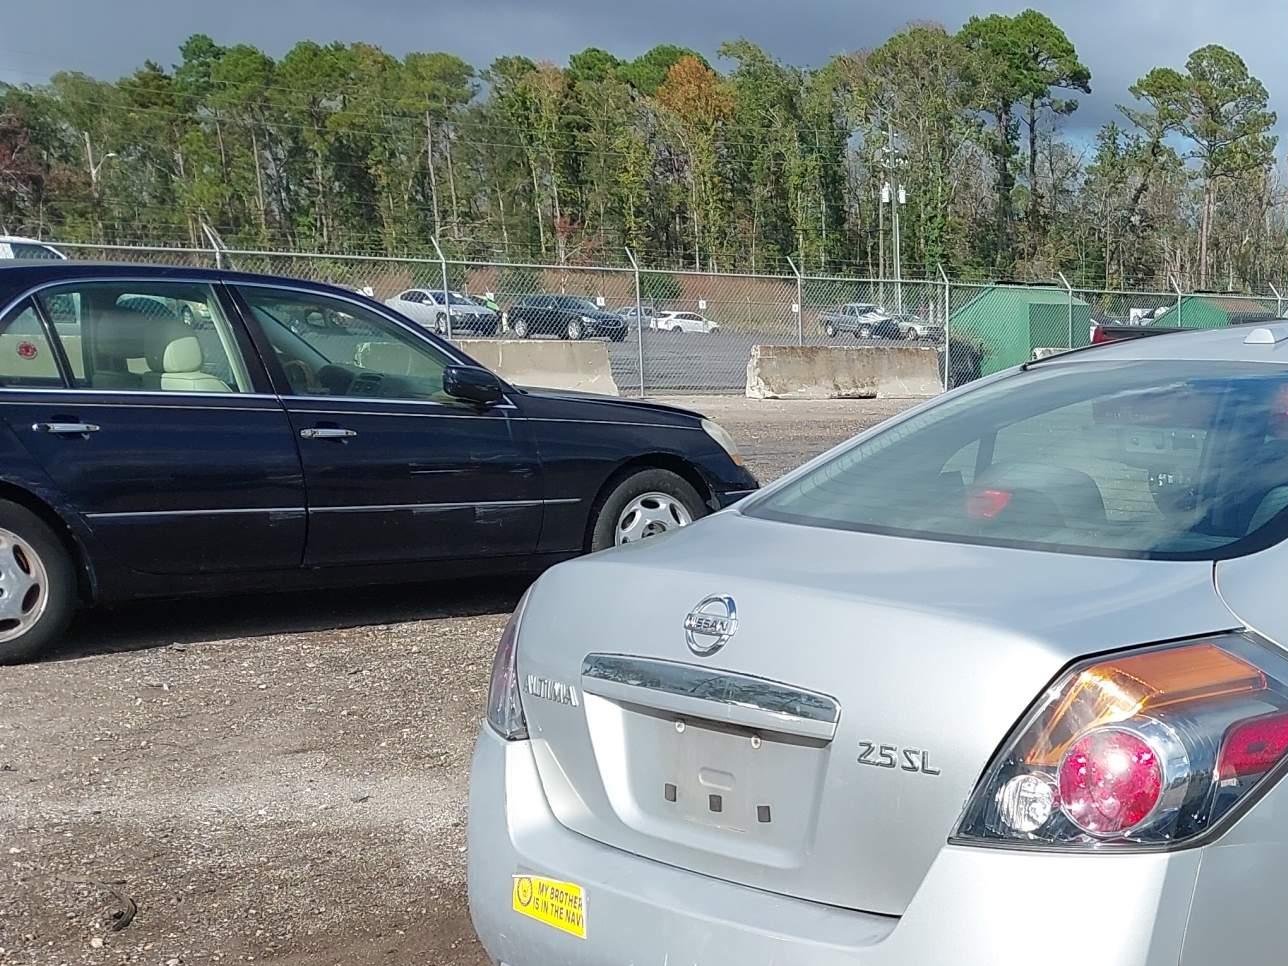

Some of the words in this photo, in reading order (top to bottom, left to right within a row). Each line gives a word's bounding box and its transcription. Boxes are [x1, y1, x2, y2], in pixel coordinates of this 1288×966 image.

[685, 615, 729, 632] NISSAN
[523, 674, 579, 707] ALTIMA
[901, 749, 941, 776] SL
[533, 896, 540, 911] IS
[541, 899, 549, 913] IN
[551, 903, 564, 920] THE
[538, 881, 549, 899] MY
[550, 887, 583, 912] BROTHER
